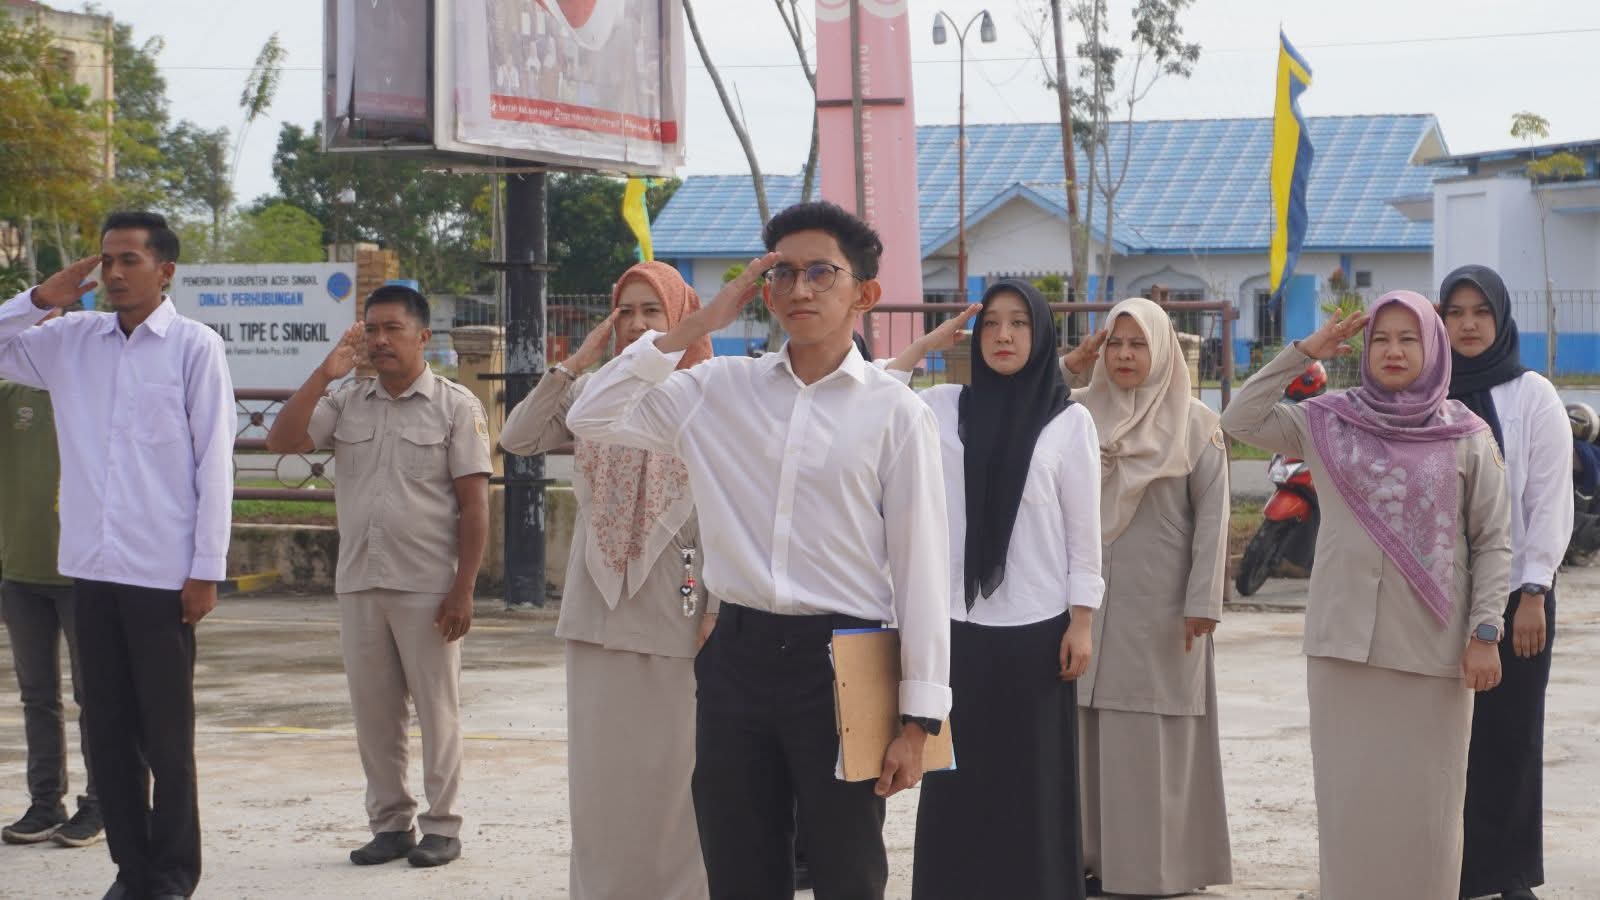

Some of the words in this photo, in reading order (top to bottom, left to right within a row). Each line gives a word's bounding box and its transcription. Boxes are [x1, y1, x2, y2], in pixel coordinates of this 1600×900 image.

[182, 276, 225, 287] PEMERINTAH
[228, 275, 268, 286] KABUPATEN
[271, 275, 289, 286] ACEH
[291, 275, 319, 286] SINGKIL
[199, 293, 227, 306] DINAS
[232, 292, 304, 306] PERHUBUNGAN
[240, 323, 267, 342] TIPE
[270, 323, 279, 342] C
[282, 323, 330, 342] SINGKIL
